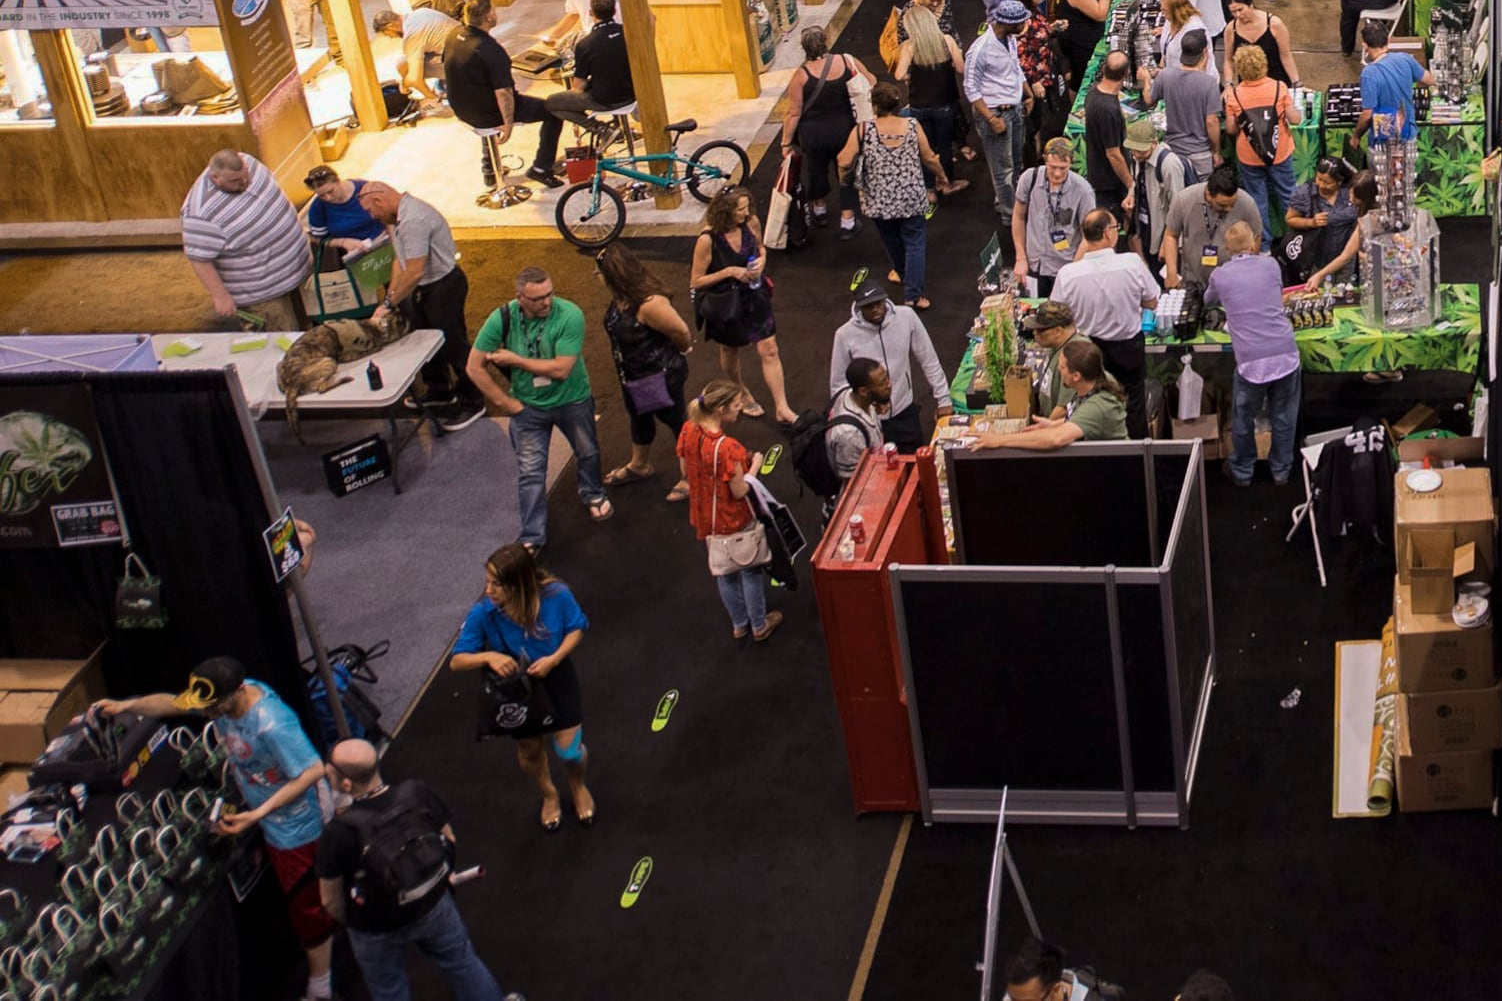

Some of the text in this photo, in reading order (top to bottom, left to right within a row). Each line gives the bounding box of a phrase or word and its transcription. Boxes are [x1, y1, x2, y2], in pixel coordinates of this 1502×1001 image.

[1, 13, 23, 22] ARD
[59, 11, 112, 21] INDUSTRY
[113, 10, 144, 20] SINCE
[146, 9, 171, 19] 1998
[339, 455, 358, 468] THE
[341, 456, 377, 477] FUTURE
[343, 474, 357, 484] OF
[345, 470, 385, 493] ROLLING
[56, 505, 116, 521] GRAB BAG
